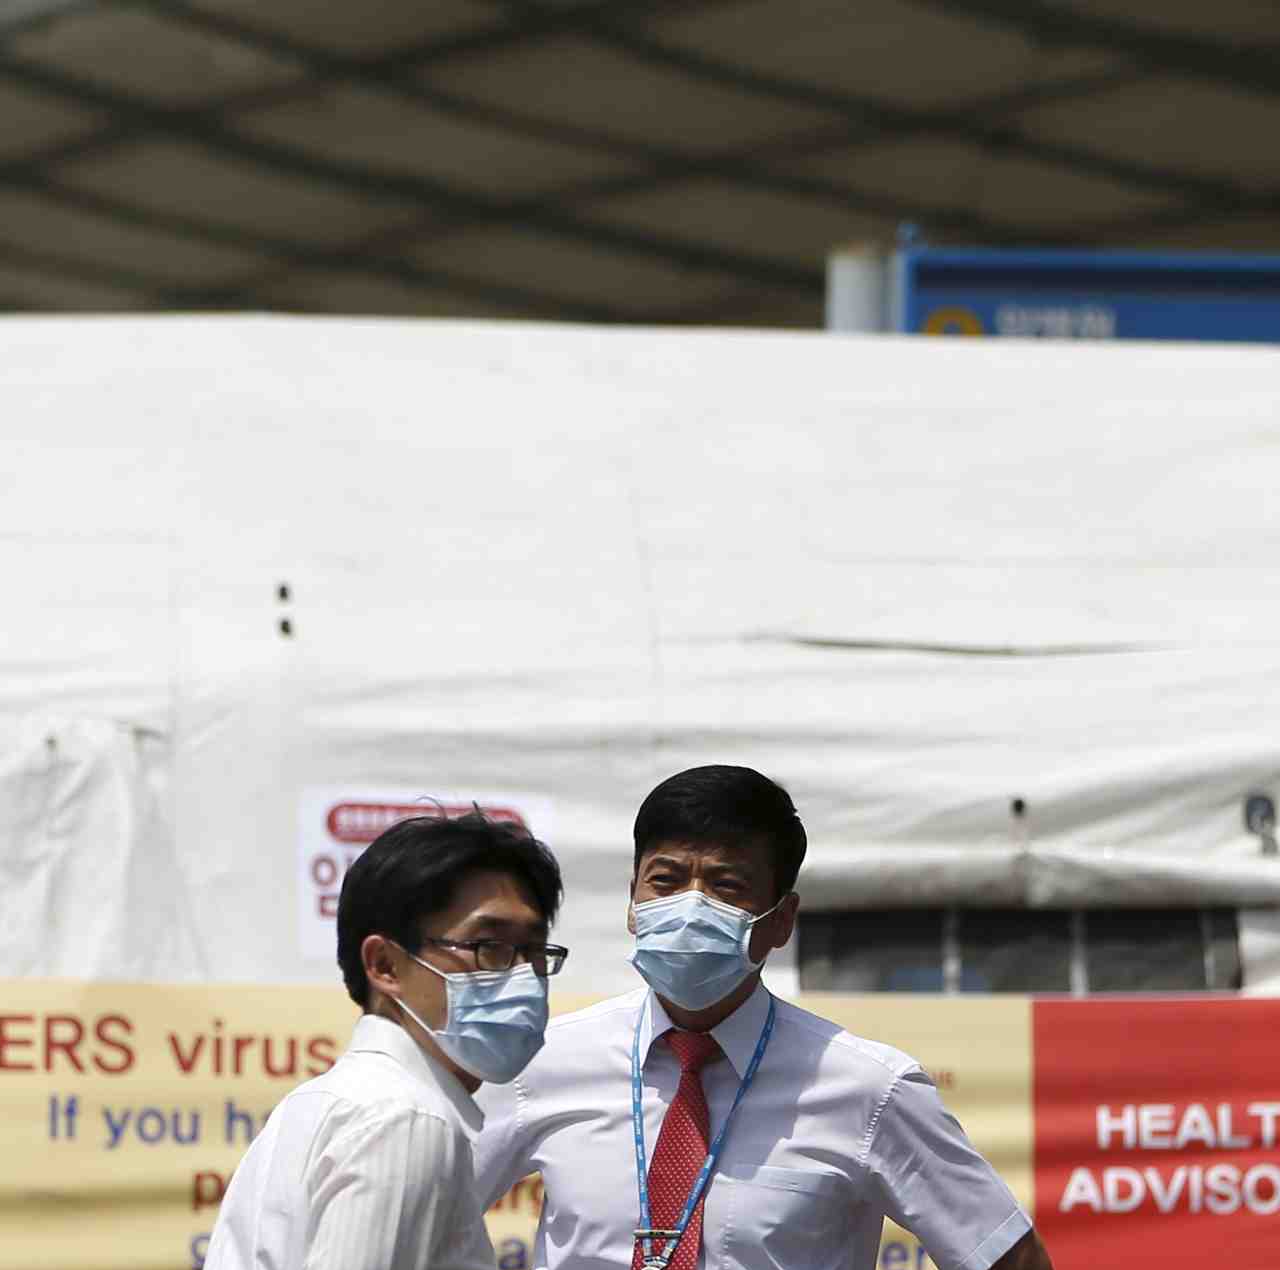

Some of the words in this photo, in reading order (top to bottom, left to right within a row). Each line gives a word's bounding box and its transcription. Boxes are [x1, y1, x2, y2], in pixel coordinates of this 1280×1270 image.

[167, 1019, 336, 1077] virus
[48, 1095, 80, 1141] If
[102, 1105, 201, 1149] you
